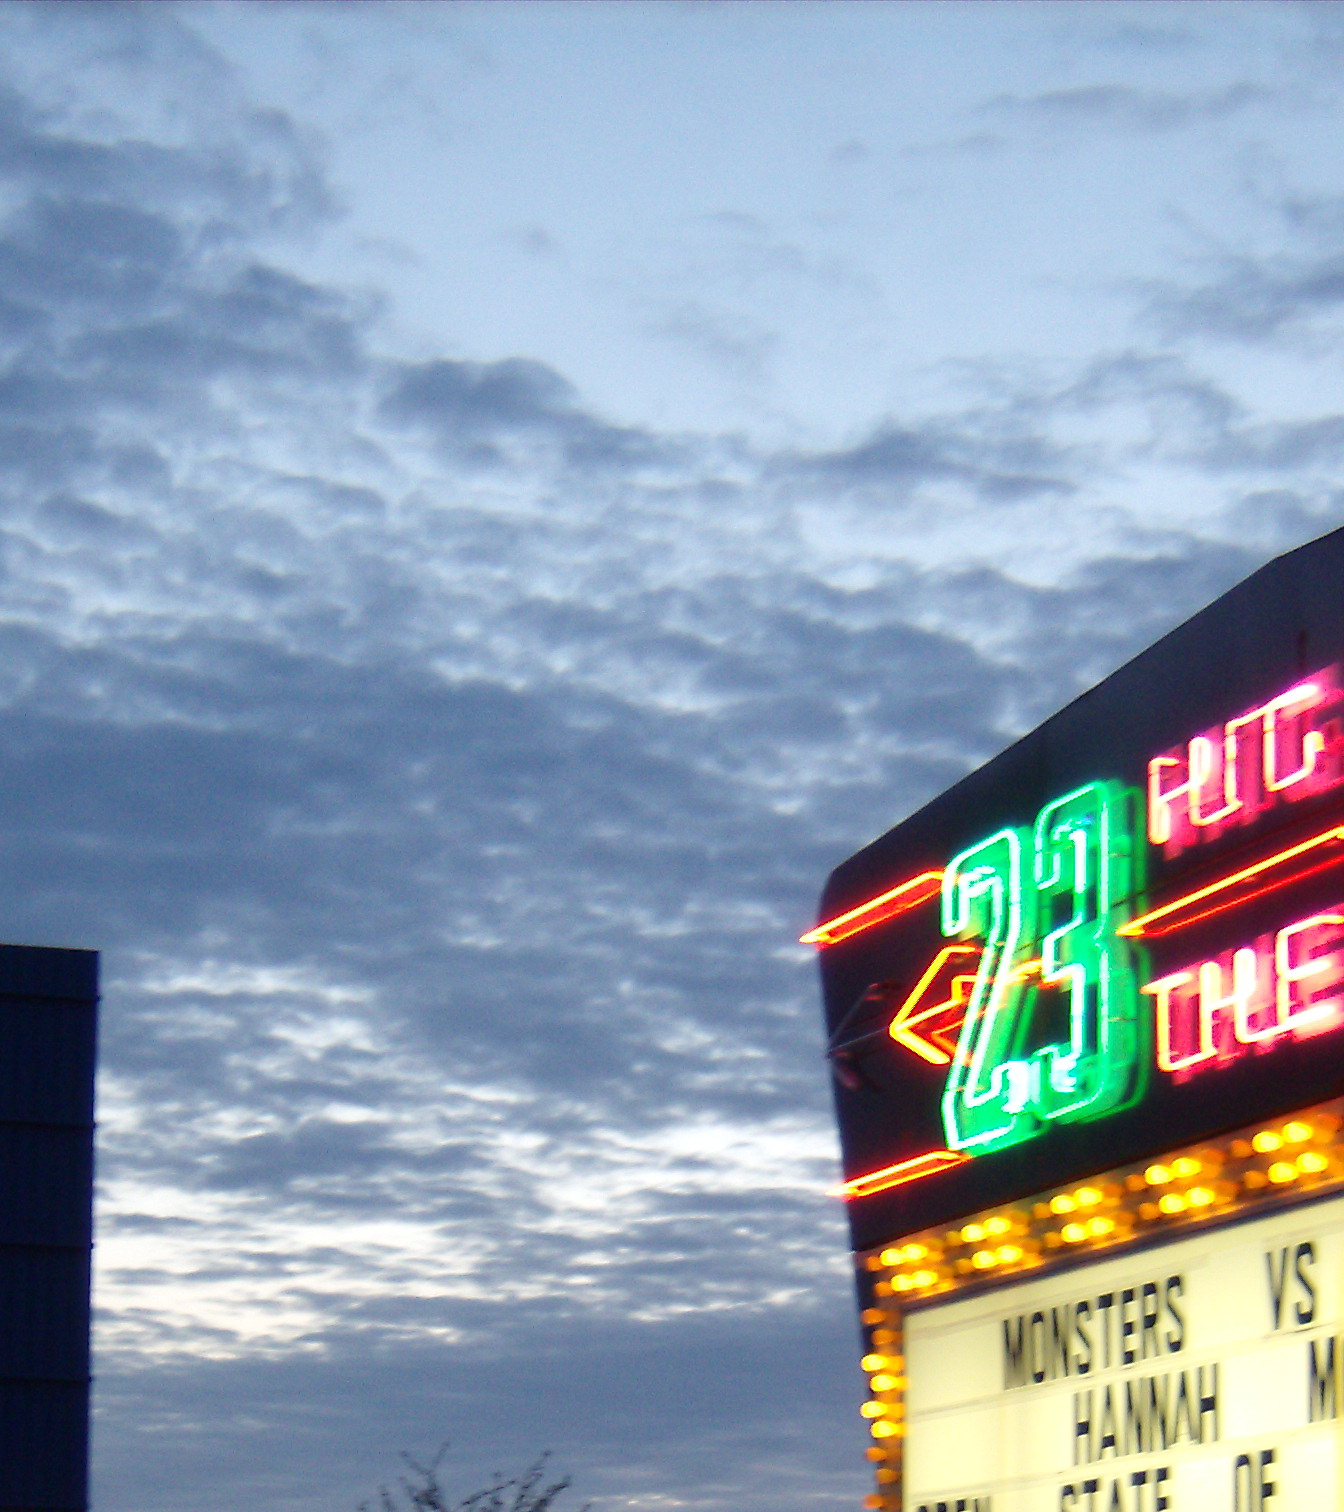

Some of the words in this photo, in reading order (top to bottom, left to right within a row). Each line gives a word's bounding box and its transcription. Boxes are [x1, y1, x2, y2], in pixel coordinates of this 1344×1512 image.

[941, 778, 1141, 1155] 23
[1002, 1274, 1185, 1391] MONSTERS
[1266, 1241, 1317, 1331] VS
[1073, 1362, 1220, 1466] HANNAH
